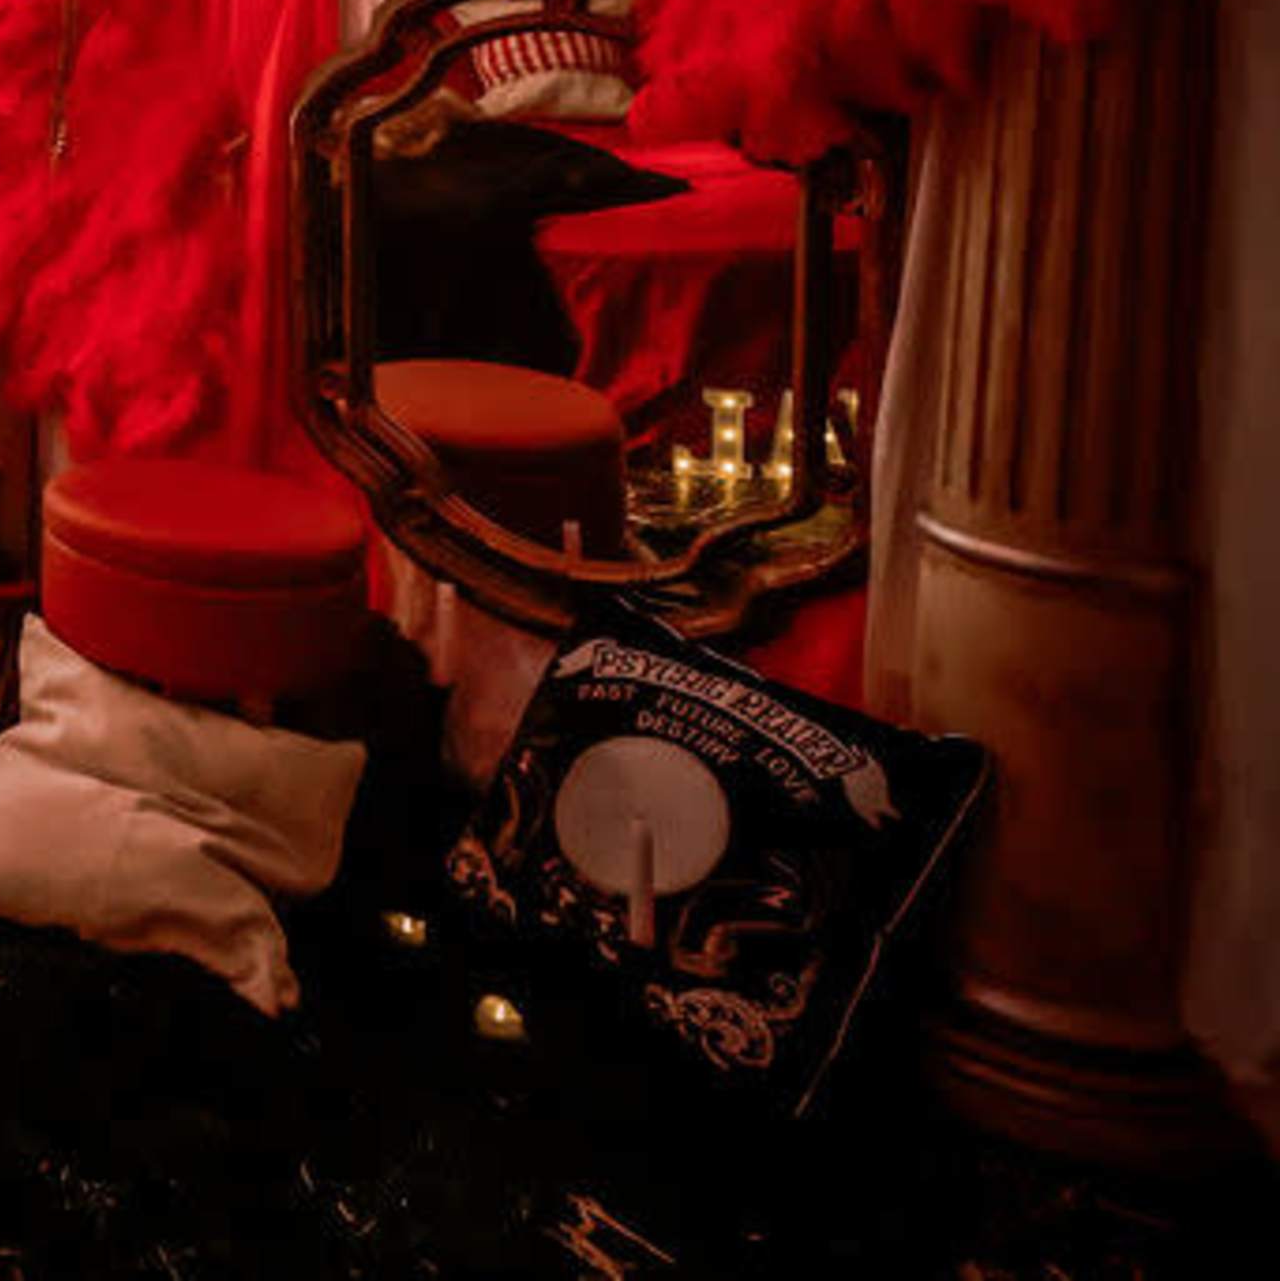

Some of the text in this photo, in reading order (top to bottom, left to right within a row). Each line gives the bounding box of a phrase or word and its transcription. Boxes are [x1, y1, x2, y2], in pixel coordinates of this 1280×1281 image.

[600, 648, 729, 698] PSYCHIC
[577, 682, 818, 804] PAST FUTURE LOVE
[634, 709, 742, 767] DESTINY
